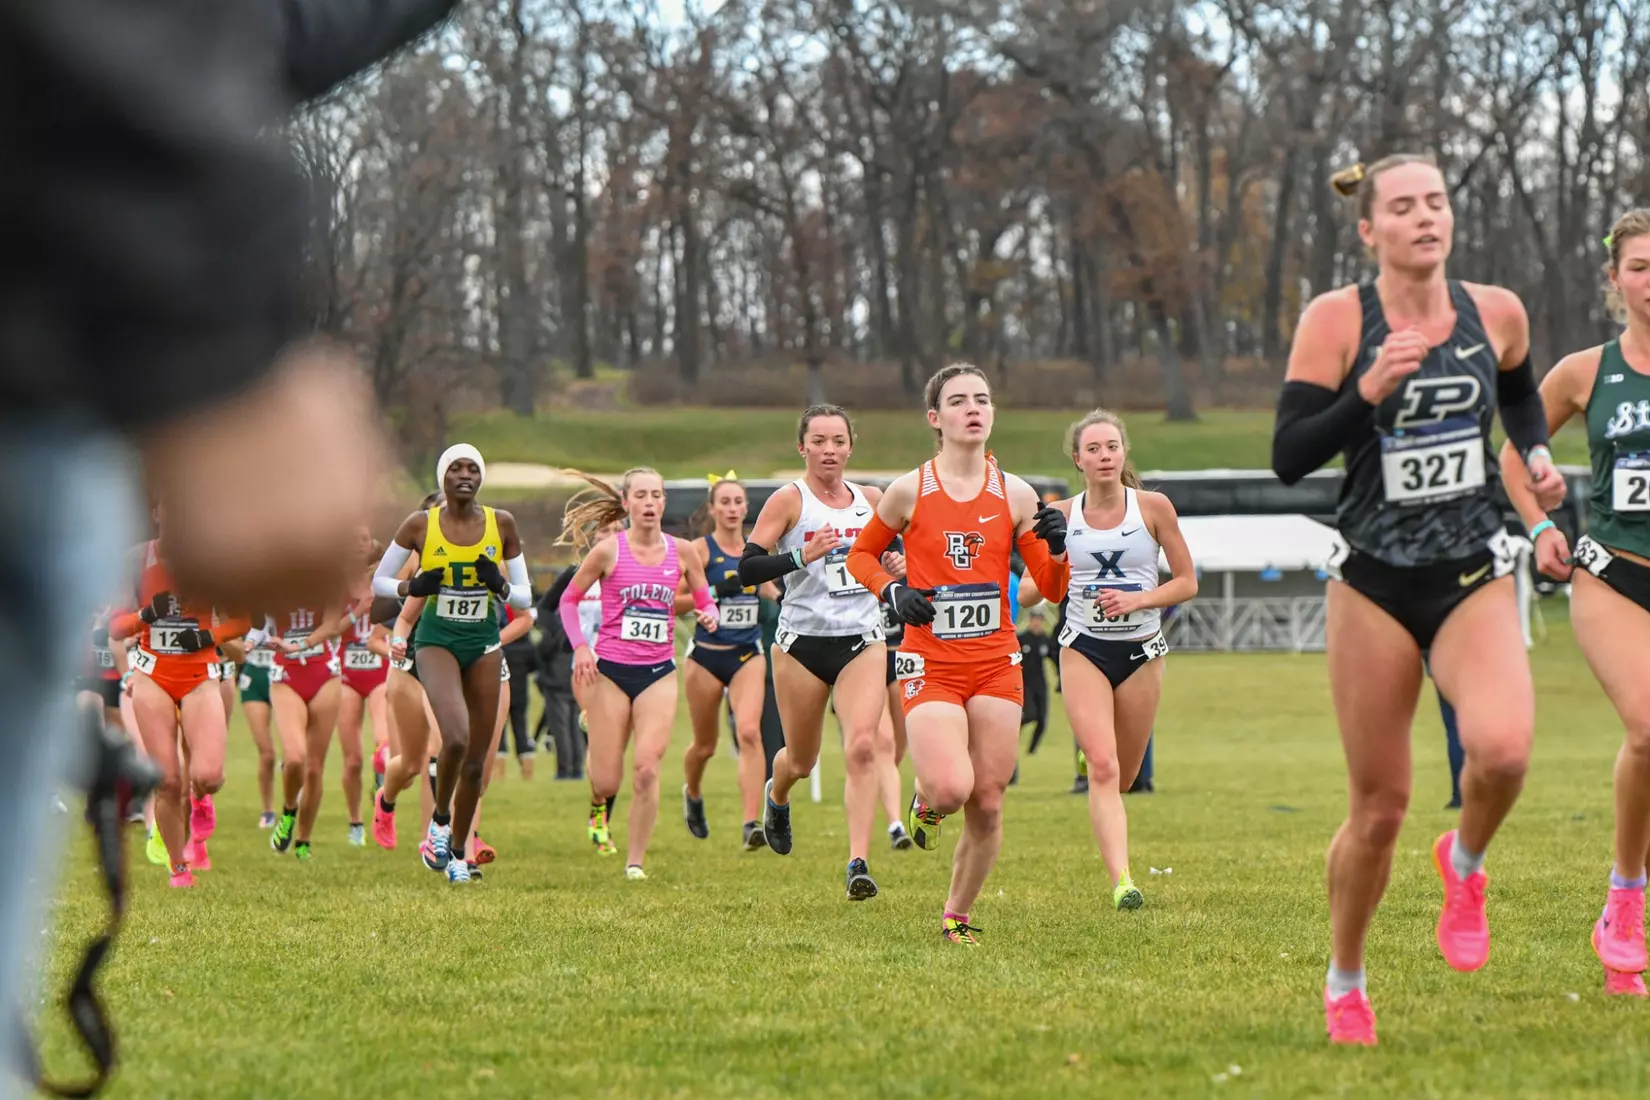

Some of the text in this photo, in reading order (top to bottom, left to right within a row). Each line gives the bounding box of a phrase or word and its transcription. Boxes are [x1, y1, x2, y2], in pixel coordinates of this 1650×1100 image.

[1394, 375, 1481, 428] P
[1401, 450, 1468, 491] 327
[1628, 476, 1650, 505] 2
[1087, 548, 1130, 581] X
[447, 599, 480, 616] 187
[727, 608, 751, 622] 251
[944, 604, 991, 629] 120
[159, 631, 180, 648] 12
[630, 621, 661, 640] 341
[1150, 636, 1167, 657] 39
[351, 653, 377, 665] 202
[896, 656, 915, 675] 20
